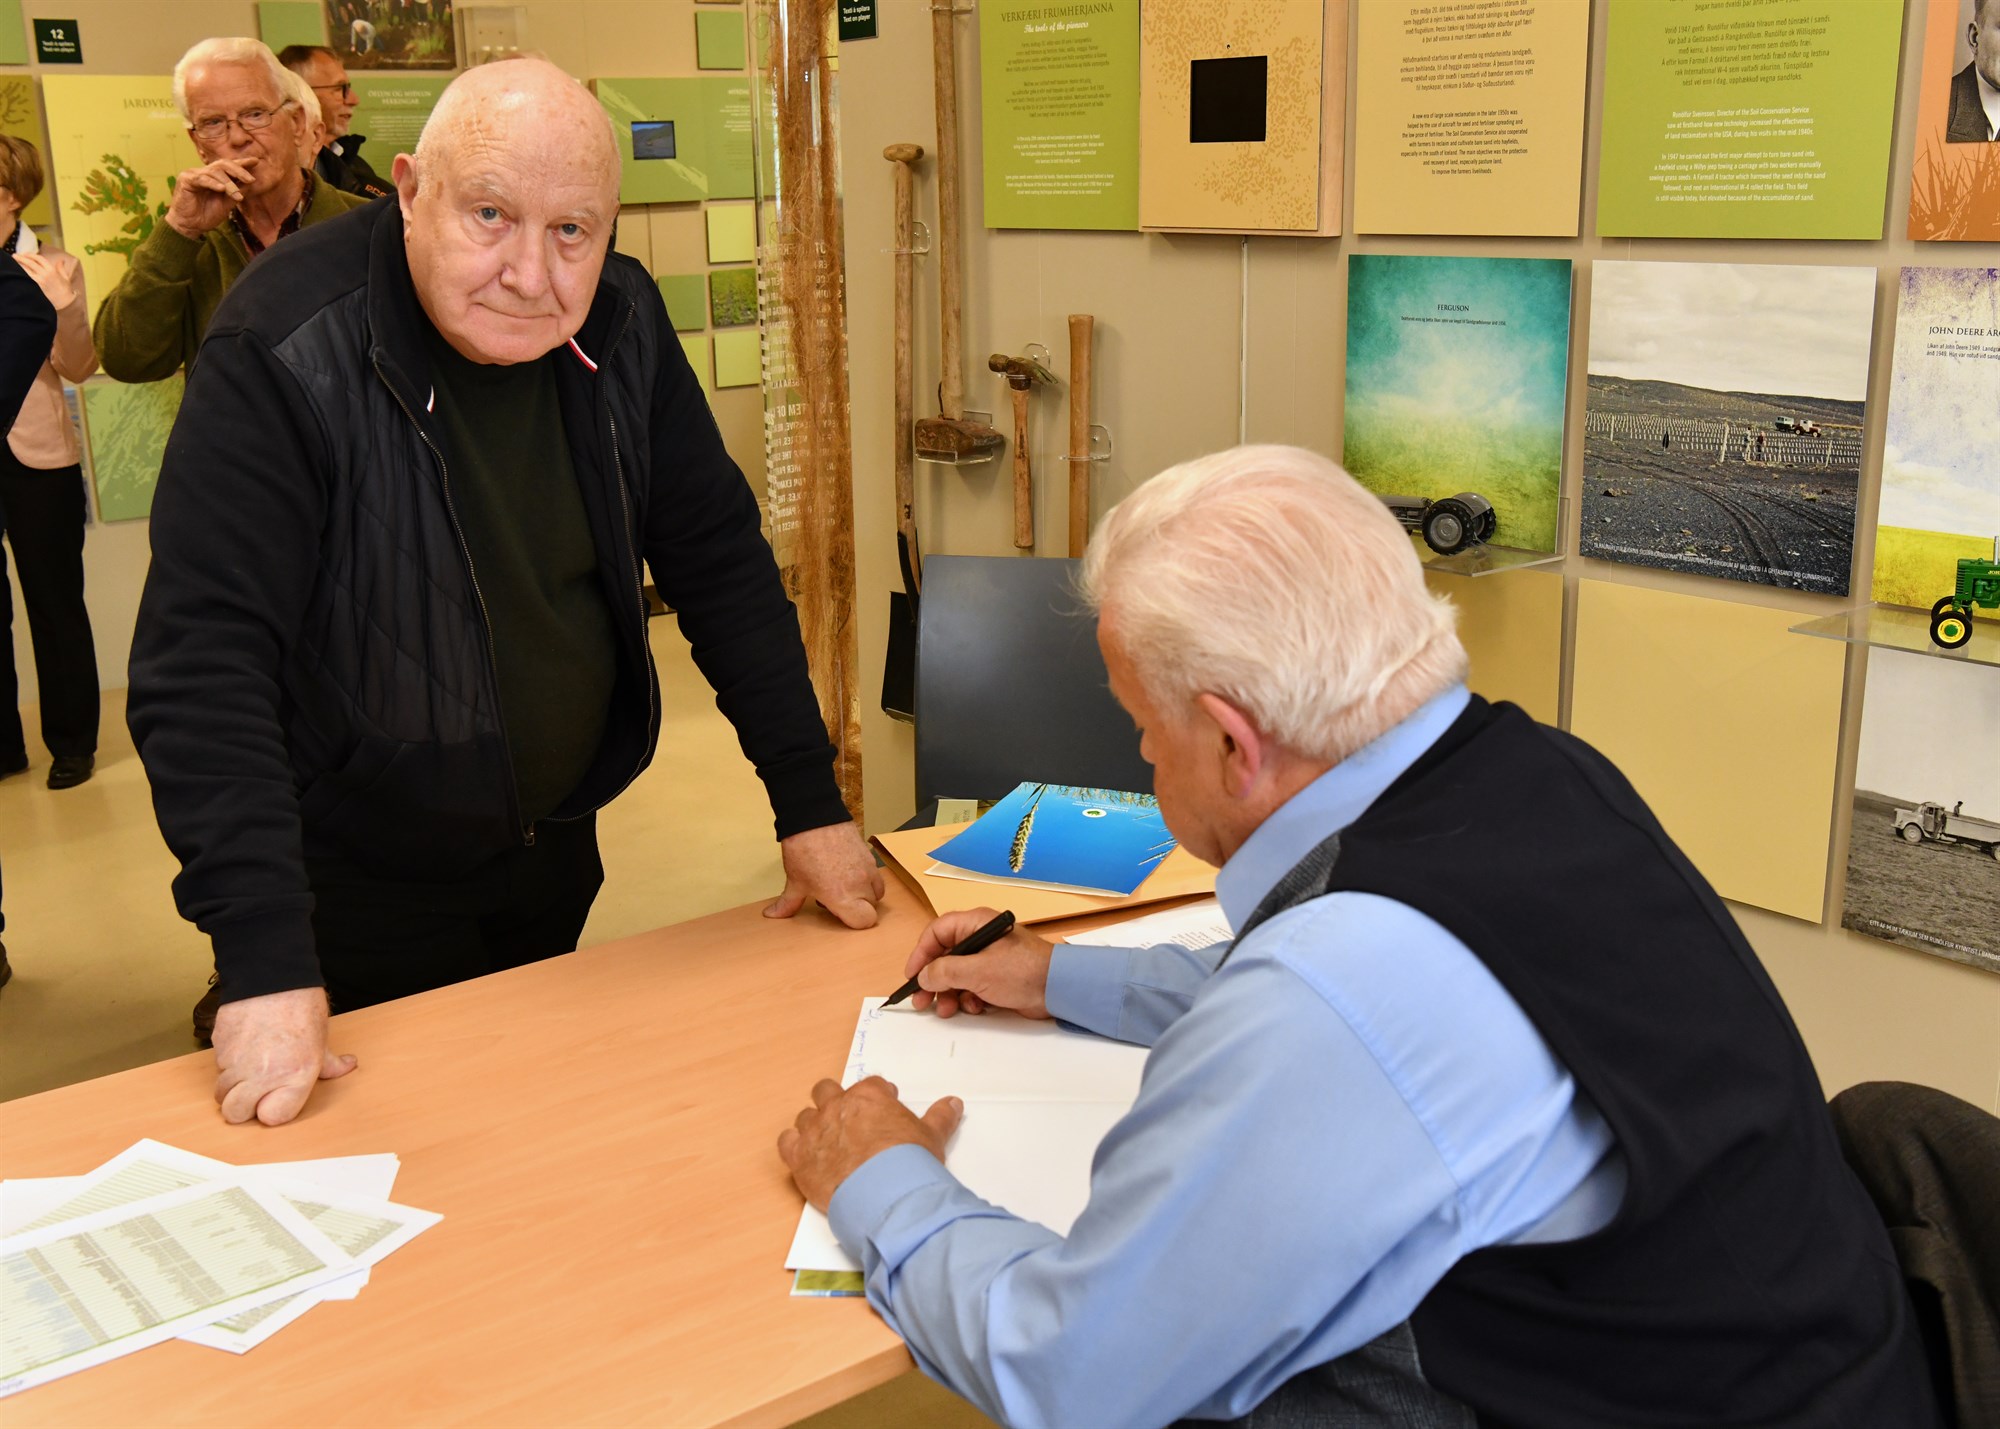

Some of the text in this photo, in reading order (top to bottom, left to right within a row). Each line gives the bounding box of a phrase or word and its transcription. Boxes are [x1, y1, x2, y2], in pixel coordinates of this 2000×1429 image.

[1001, 2, 1113, 22] VERKFÆRI FRUMHERJANNA
[50, 29, 64, 39] 12
